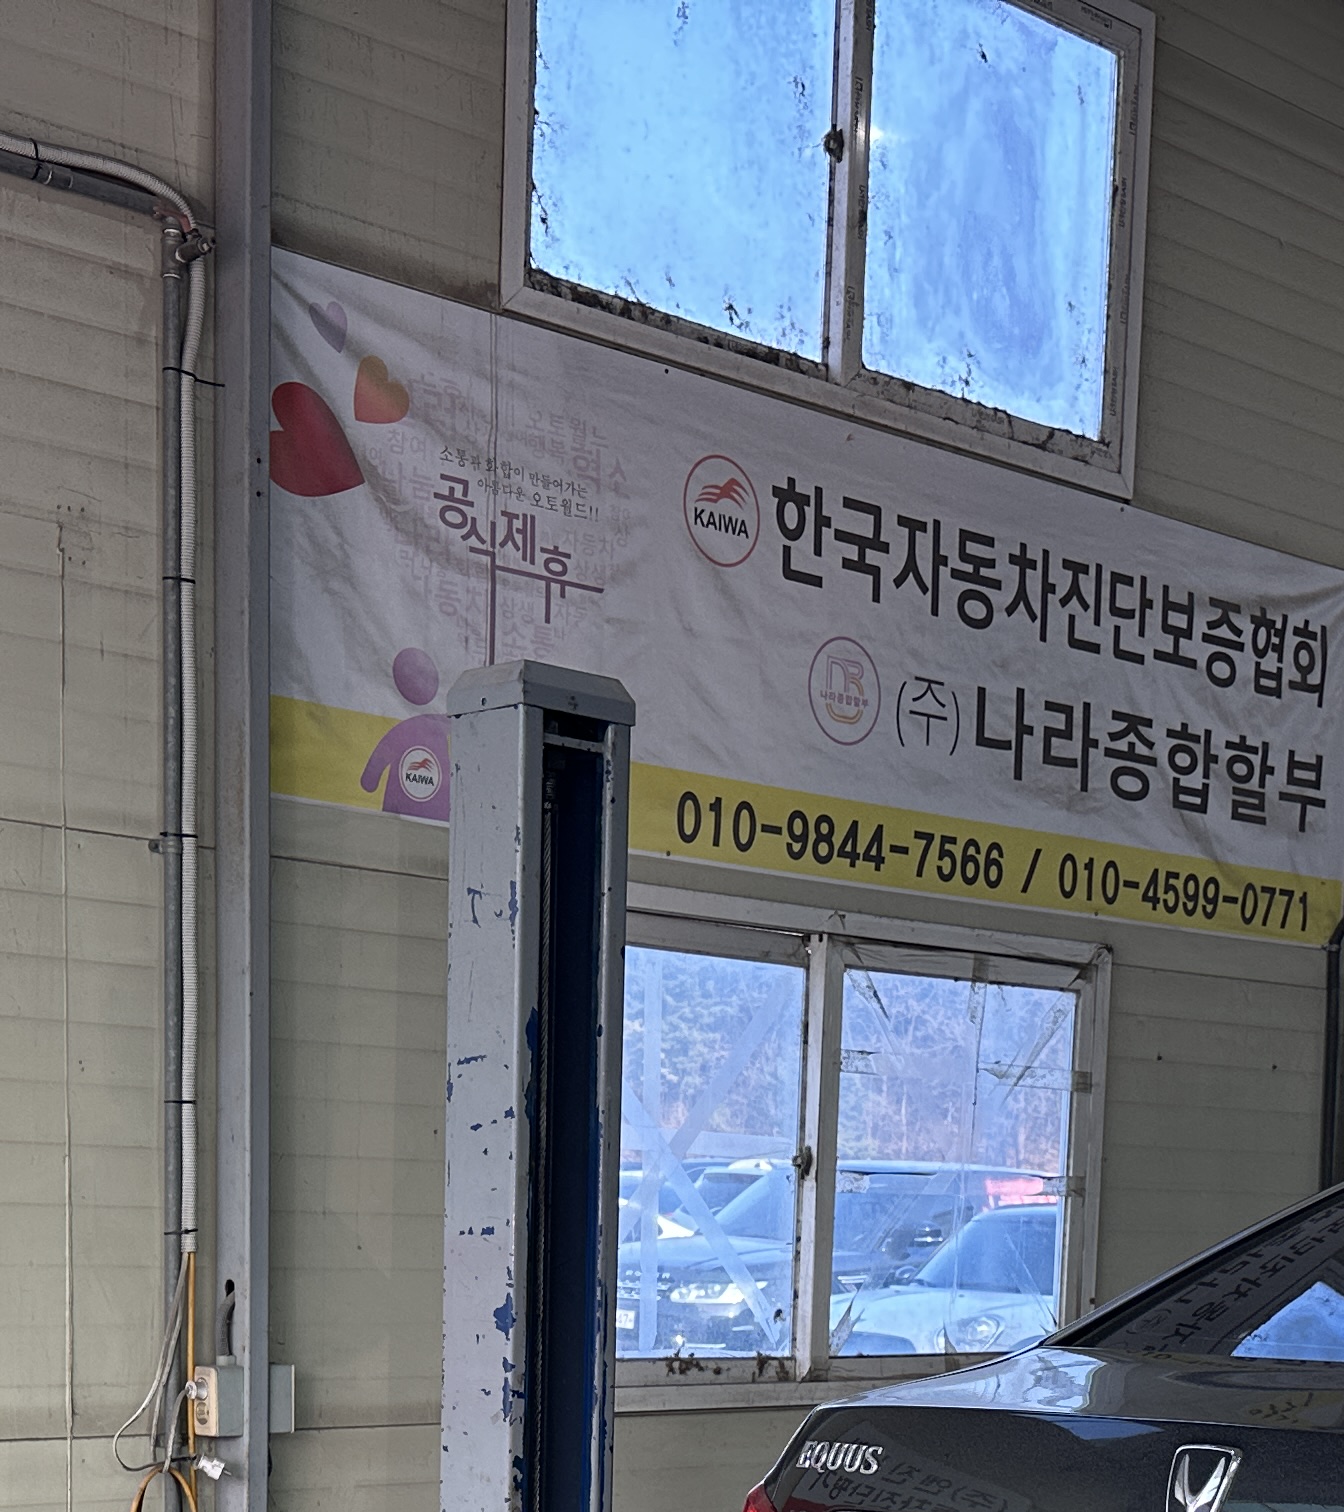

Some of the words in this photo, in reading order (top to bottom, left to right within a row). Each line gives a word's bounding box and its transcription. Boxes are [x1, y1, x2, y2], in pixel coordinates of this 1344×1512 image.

[439, 445, 482, 471] 소통과
[485, 457, 525, 482] 화합이
[528, 471, 589, 498] 만들어가는
[531, 491, 600, 523] 오토월드!!
[692, 503, 752, 540] KAIWA
[771, 476, 1329, 709] 한국자동차진단보증협회
[896, 675, 960, 757] (주)
[974, 681, 1329, 834] 나라종합할부
[405, 772, 435, 787] KAIWA
[677, 791, 1006, 886] 010-9844-7566
[1058, 851, 1312, 934] 010-4599-0771
[796, 1440, 883, 1475] EQUUS
